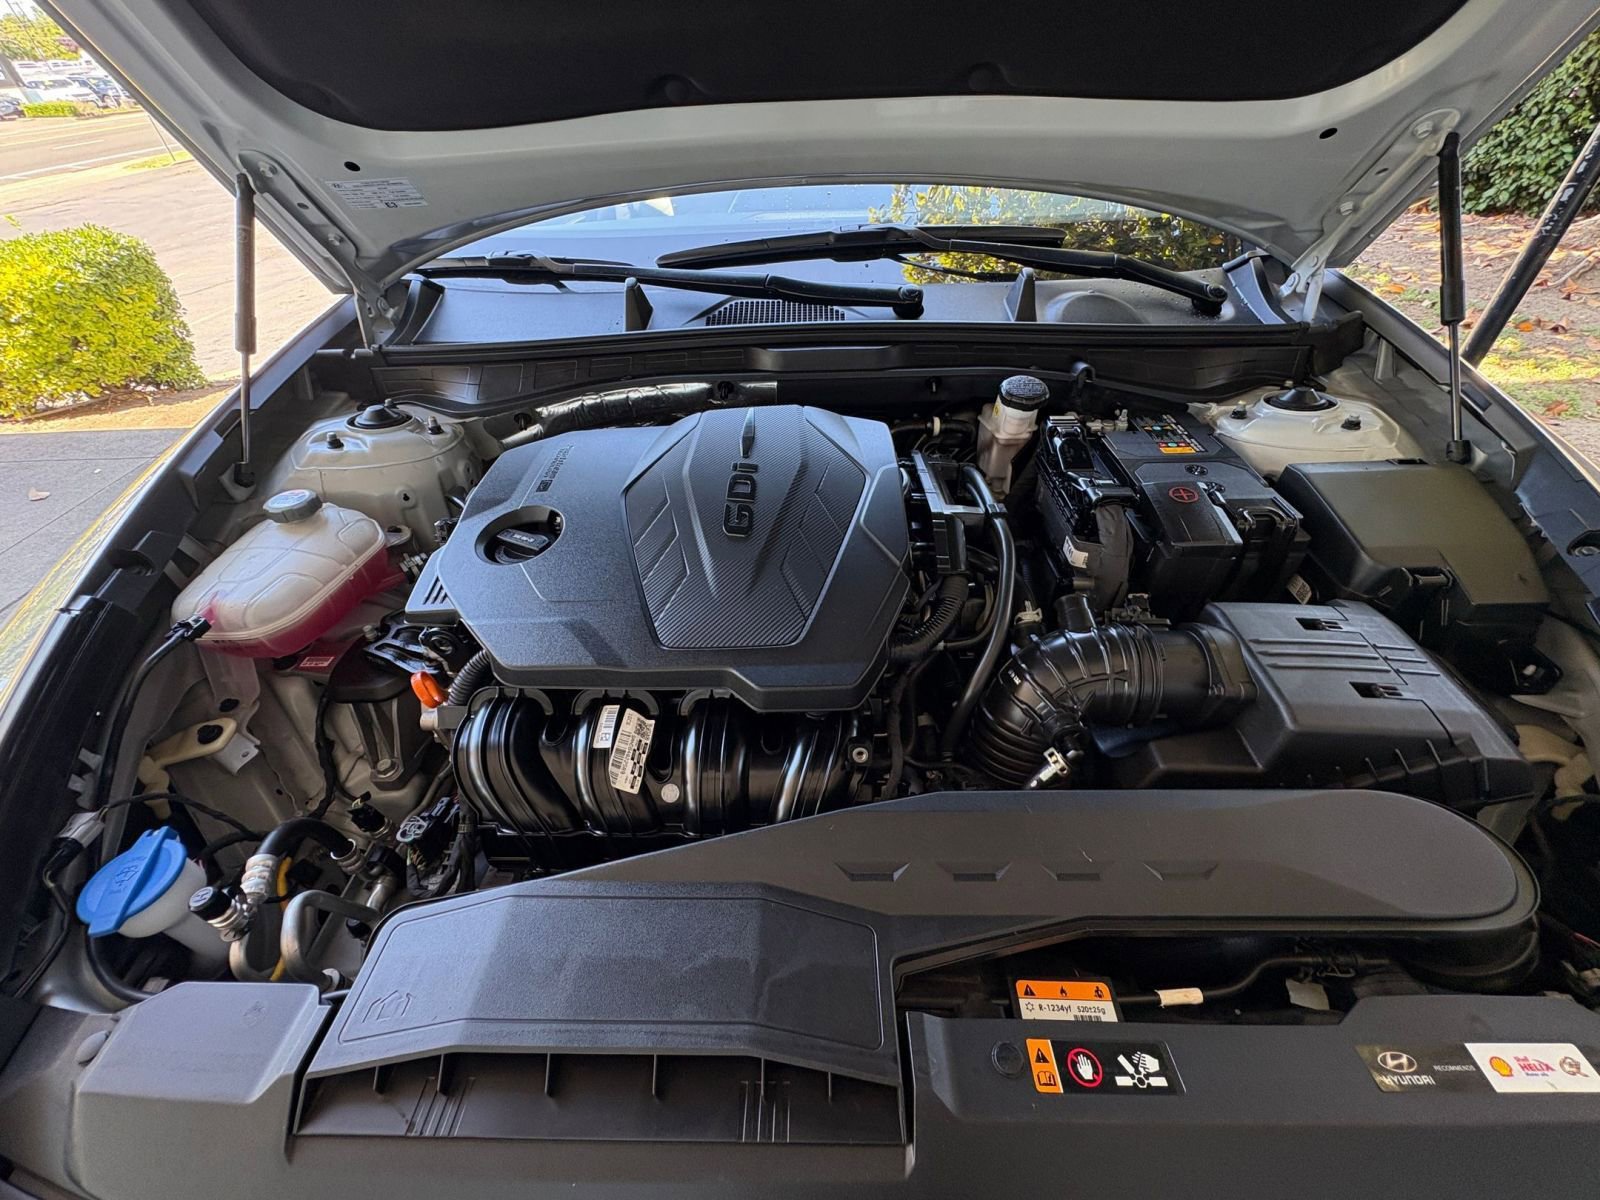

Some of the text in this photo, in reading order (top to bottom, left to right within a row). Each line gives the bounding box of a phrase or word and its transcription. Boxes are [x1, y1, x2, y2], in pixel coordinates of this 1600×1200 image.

[722, 462, 759, 537] GDi
[1038, 1003, 1072, 1014] R-1234yf
[1518, 1061, 1556, 1072] HELIX
[1382, 1074, 1437, 1086] HYUNDAI
